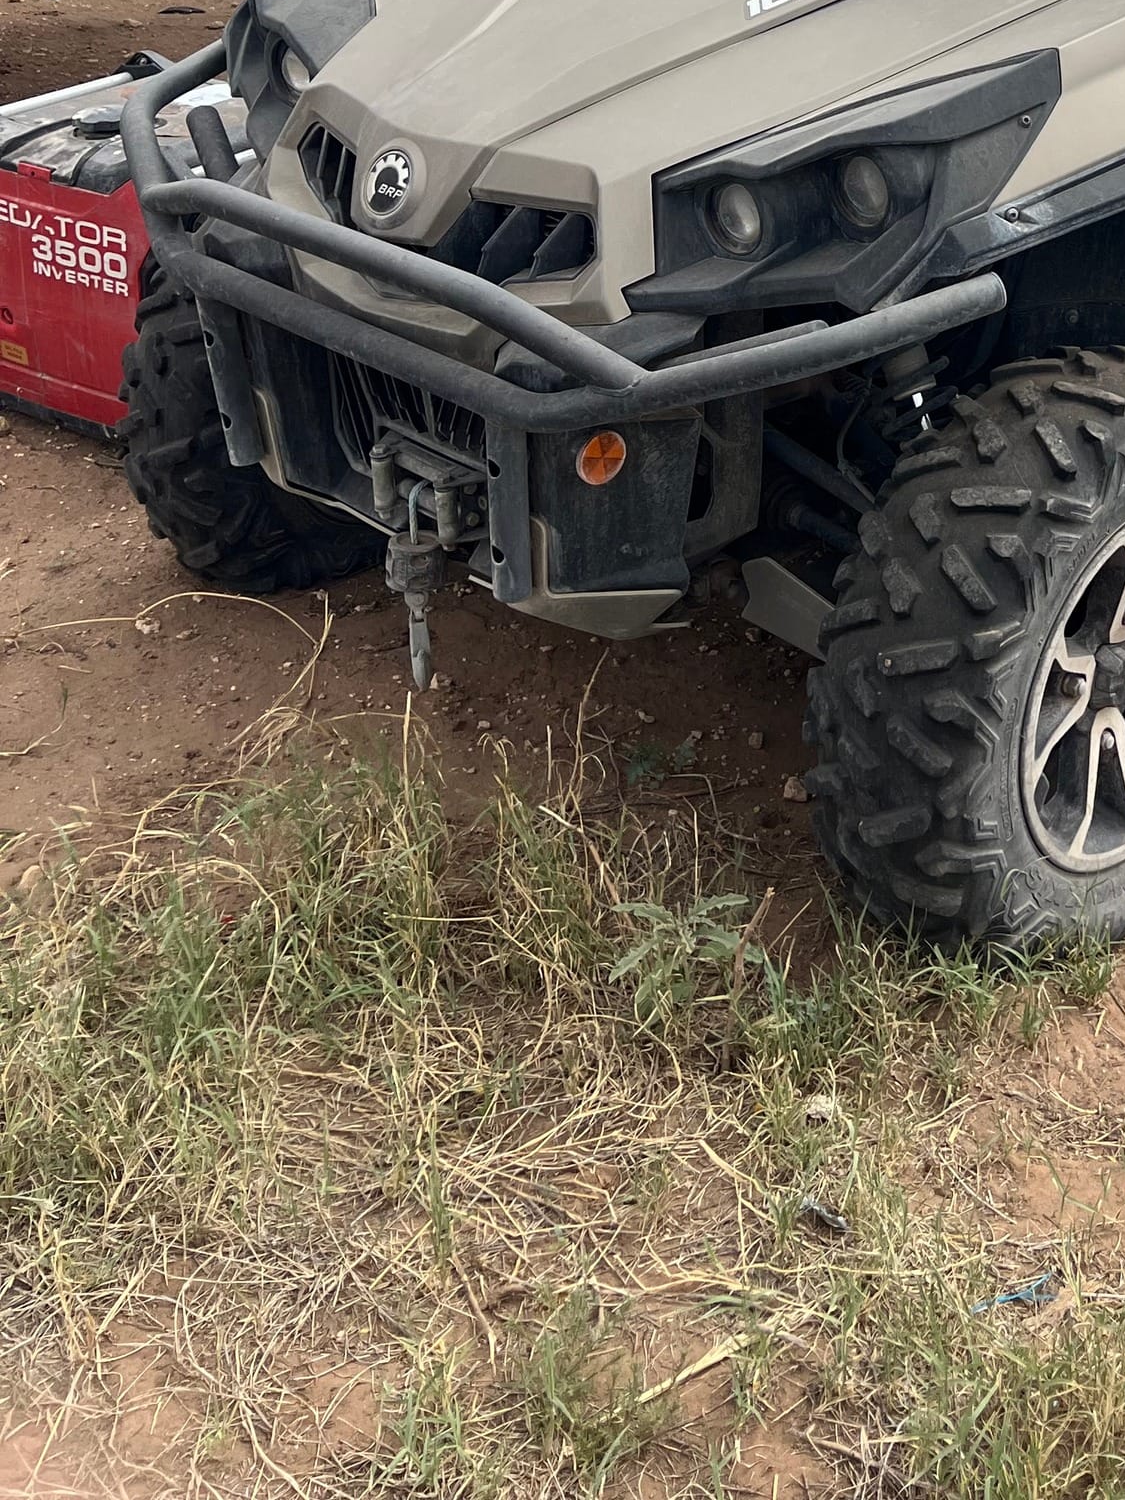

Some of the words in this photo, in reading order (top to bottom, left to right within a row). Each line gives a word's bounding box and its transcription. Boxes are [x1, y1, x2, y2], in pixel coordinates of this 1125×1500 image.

[378, 183, 403, 199] BRP
[32, 234, 127, 280] 3500
[33, 260, 129, 297] INVERTER
